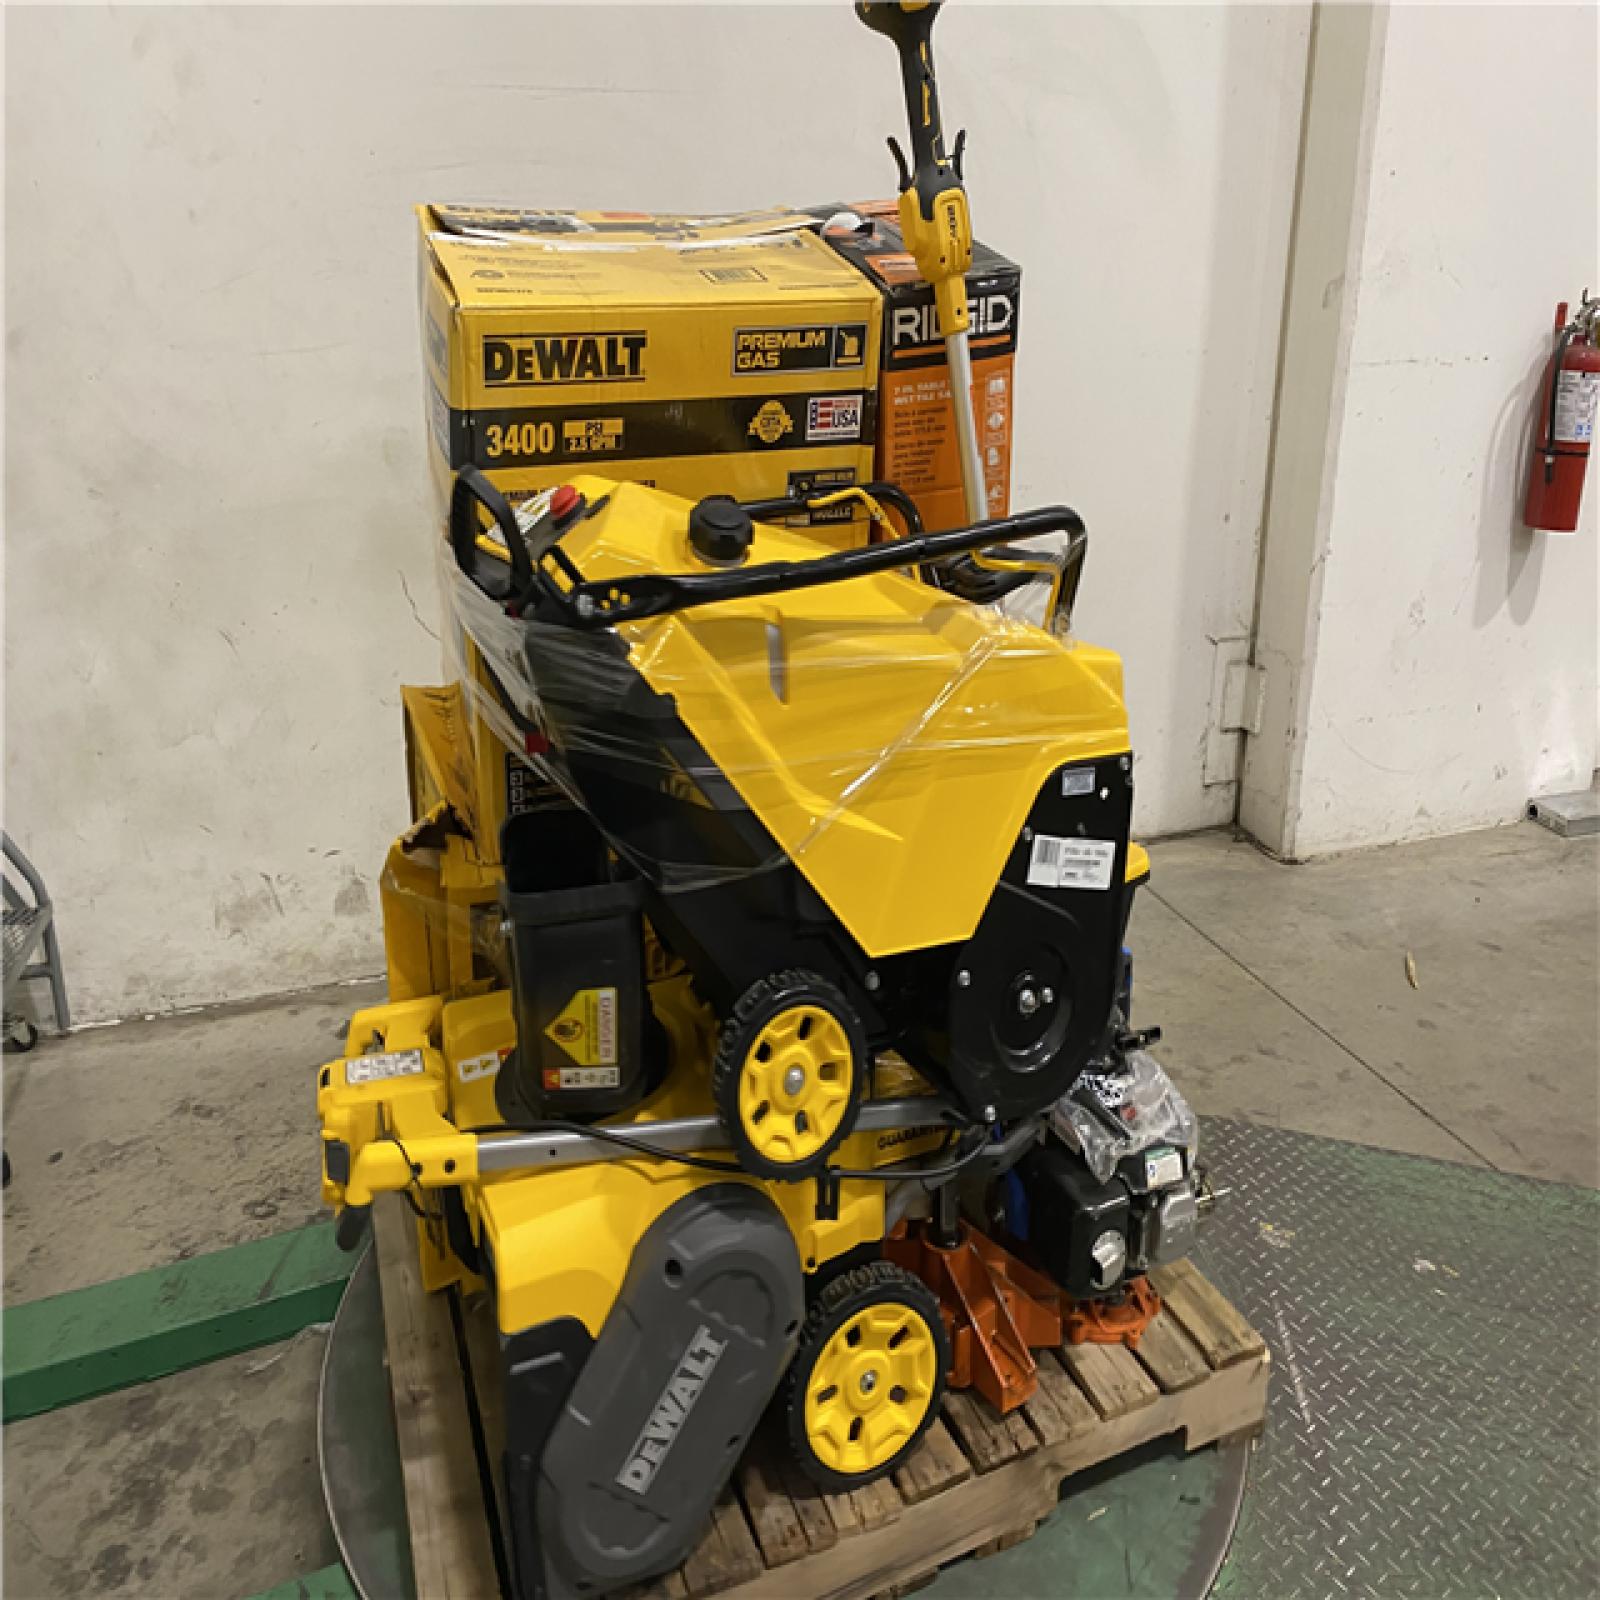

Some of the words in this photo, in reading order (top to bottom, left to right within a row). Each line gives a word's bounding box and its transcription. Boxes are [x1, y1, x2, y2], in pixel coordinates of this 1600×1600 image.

[736, 329, 826, 351] PREMIUM
[482, 335, 647, 382] DEWALT
[736, 351, 780, 369] GAS
[832, 408, 859, 428] USA
[486, 422, 554, 457] 3400
[614, 1324, 729, 1495] DEWALT
